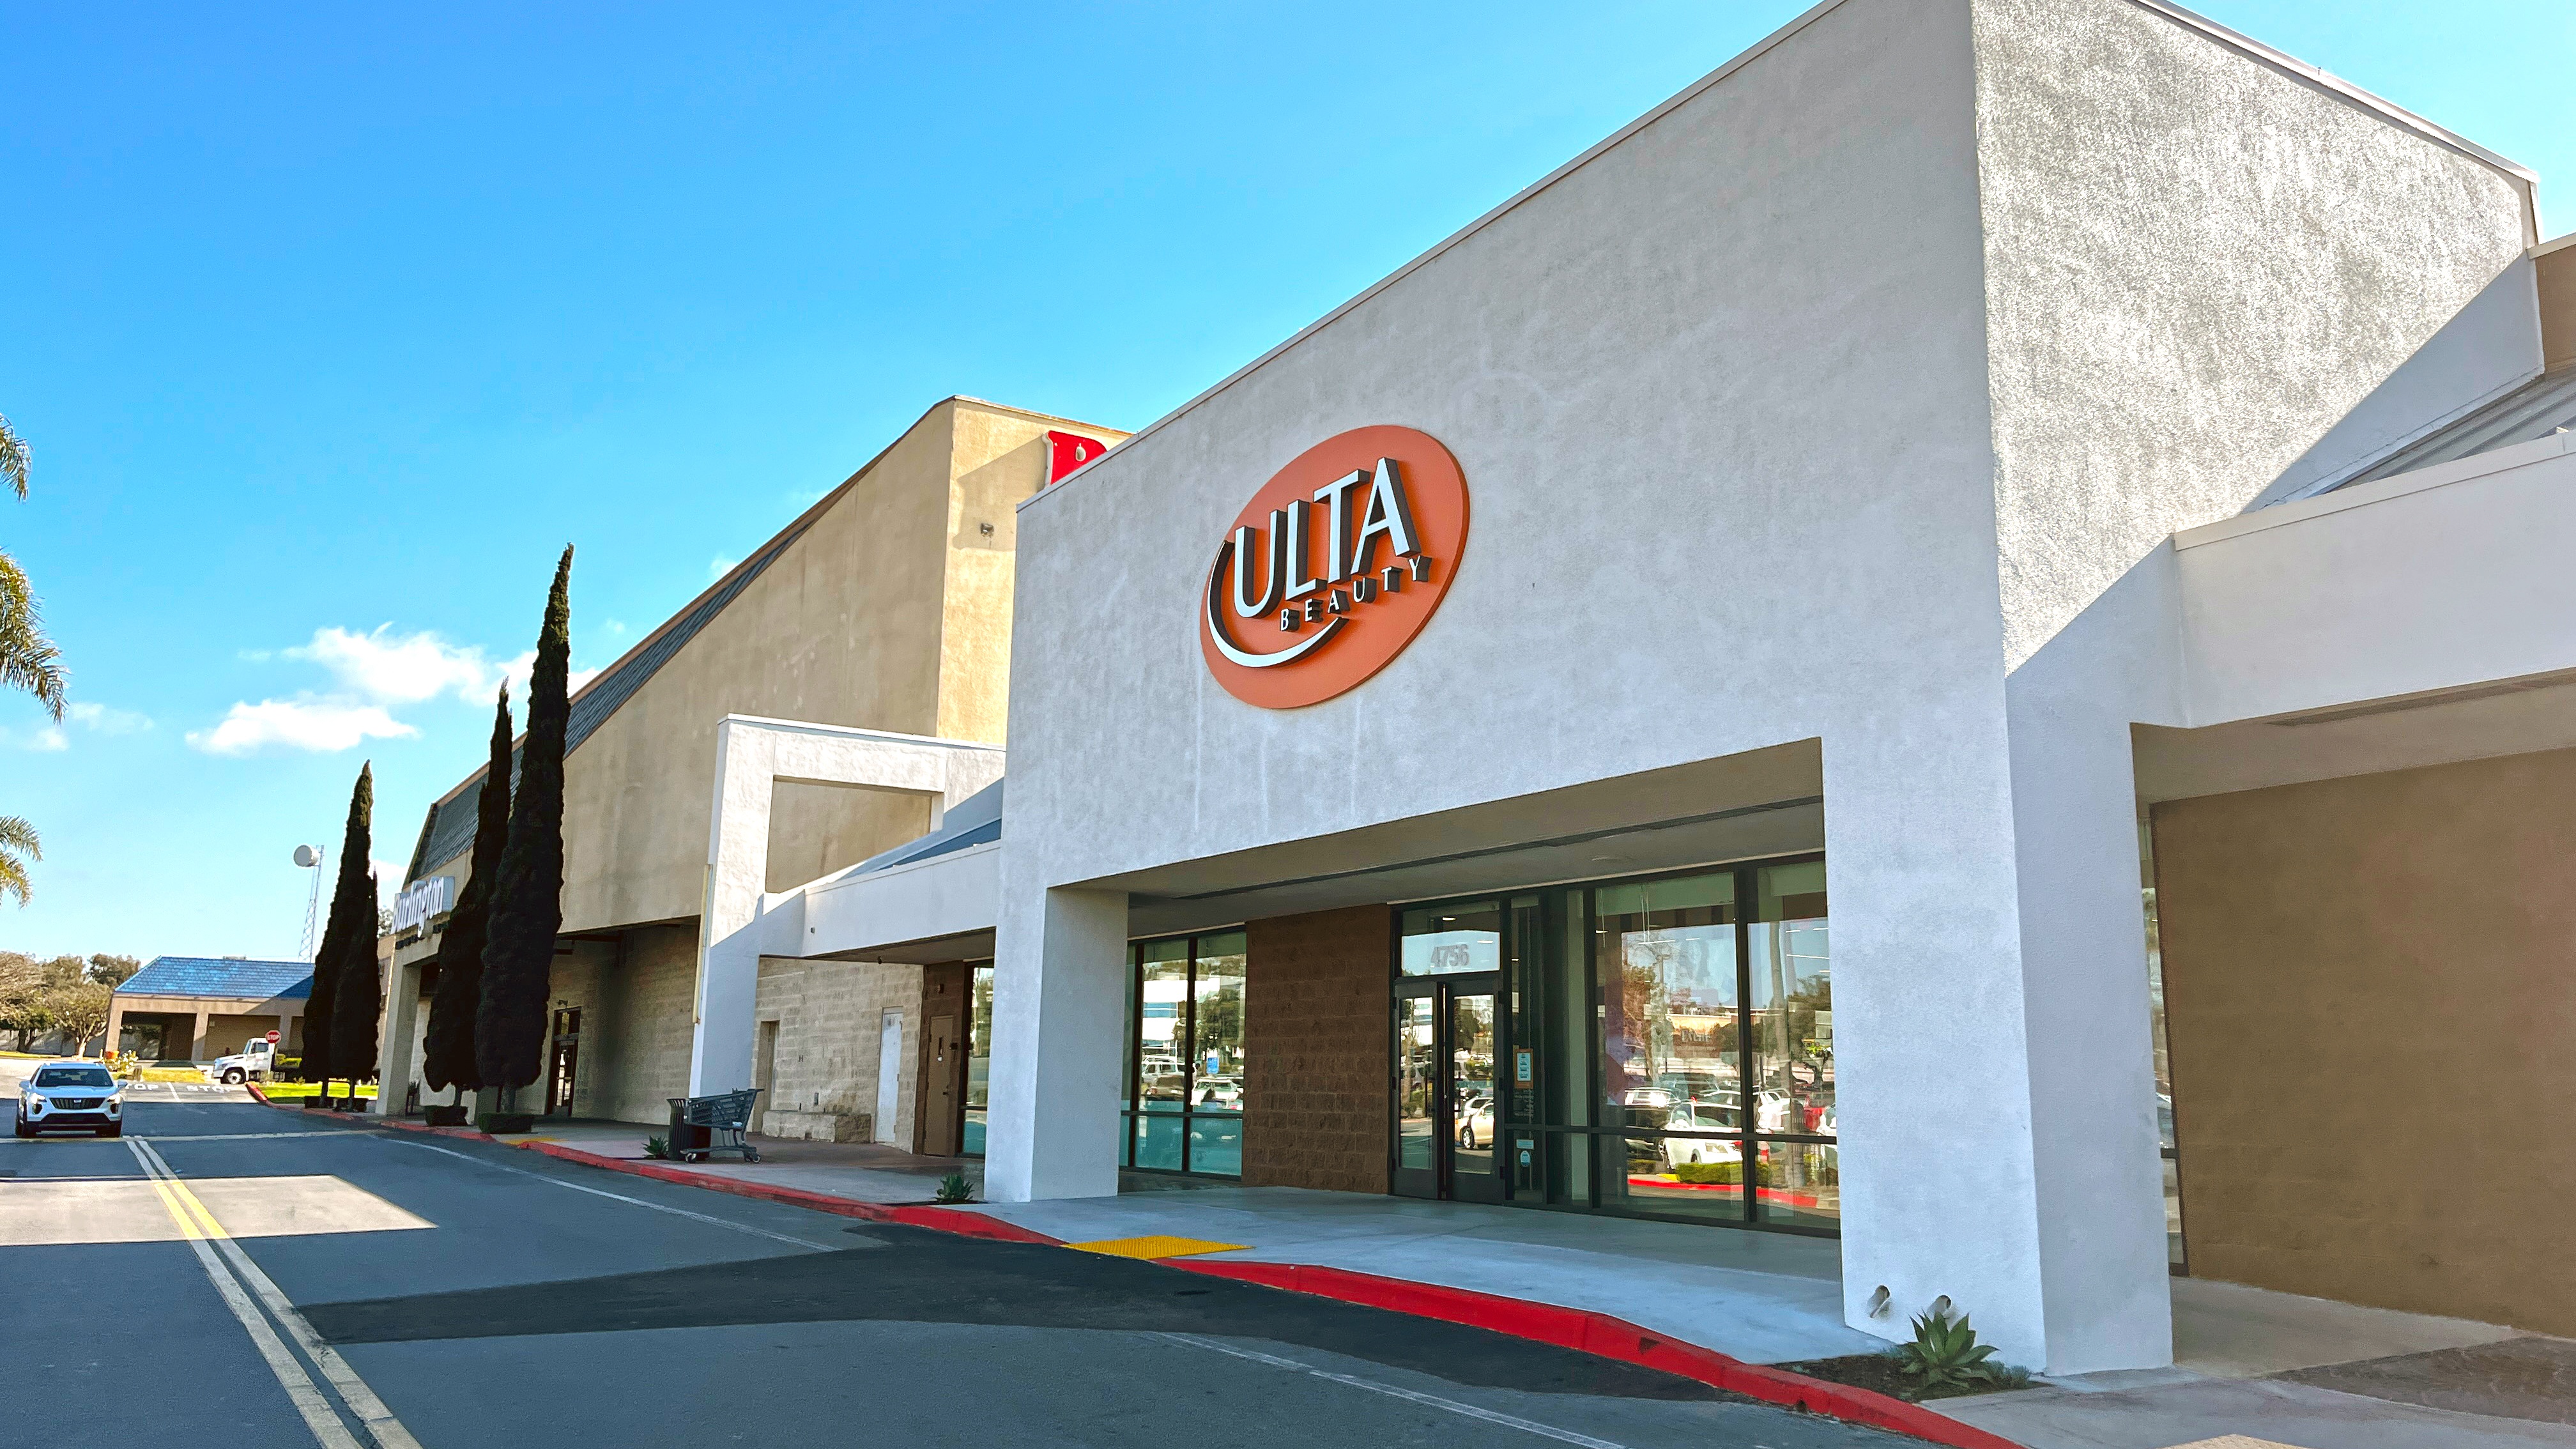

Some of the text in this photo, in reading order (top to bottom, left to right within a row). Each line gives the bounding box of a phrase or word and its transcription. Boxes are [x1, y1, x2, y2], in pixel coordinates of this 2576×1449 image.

[1233, 457, 1421, 618] ULTA
[1280, 556, 1431, 631] BEAUTY
[1430, 944, 1470, 967] 4756
